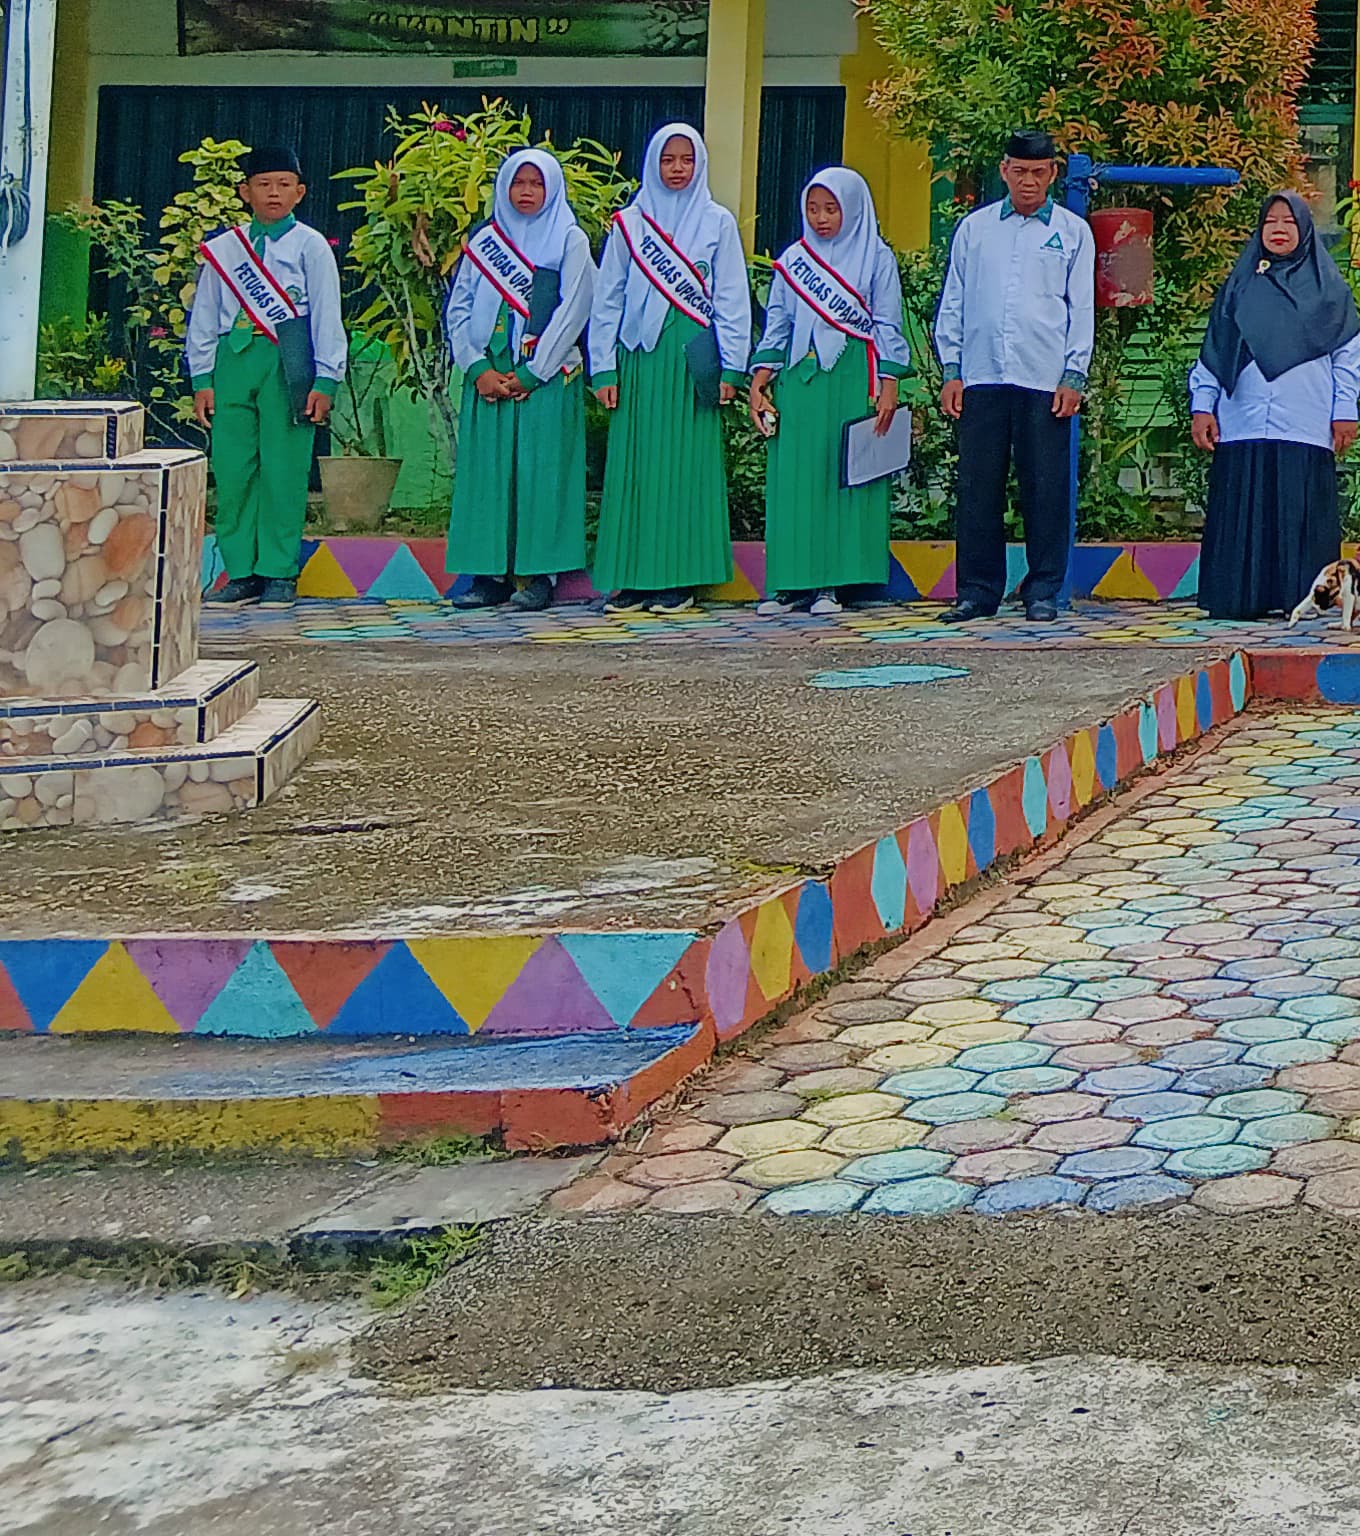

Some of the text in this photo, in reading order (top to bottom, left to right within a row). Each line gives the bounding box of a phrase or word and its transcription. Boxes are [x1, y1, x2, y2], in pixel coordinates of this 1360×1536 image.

[396, 15, 540, 44] KANTIN
[477, 235, 517, 277] PETUGAS
[640, 235, 683, 284] PETUGAS
[233, 261, 288, 324] PETUGAS UP
[788, 256, 874, 335] PETUGAS UPACARA
